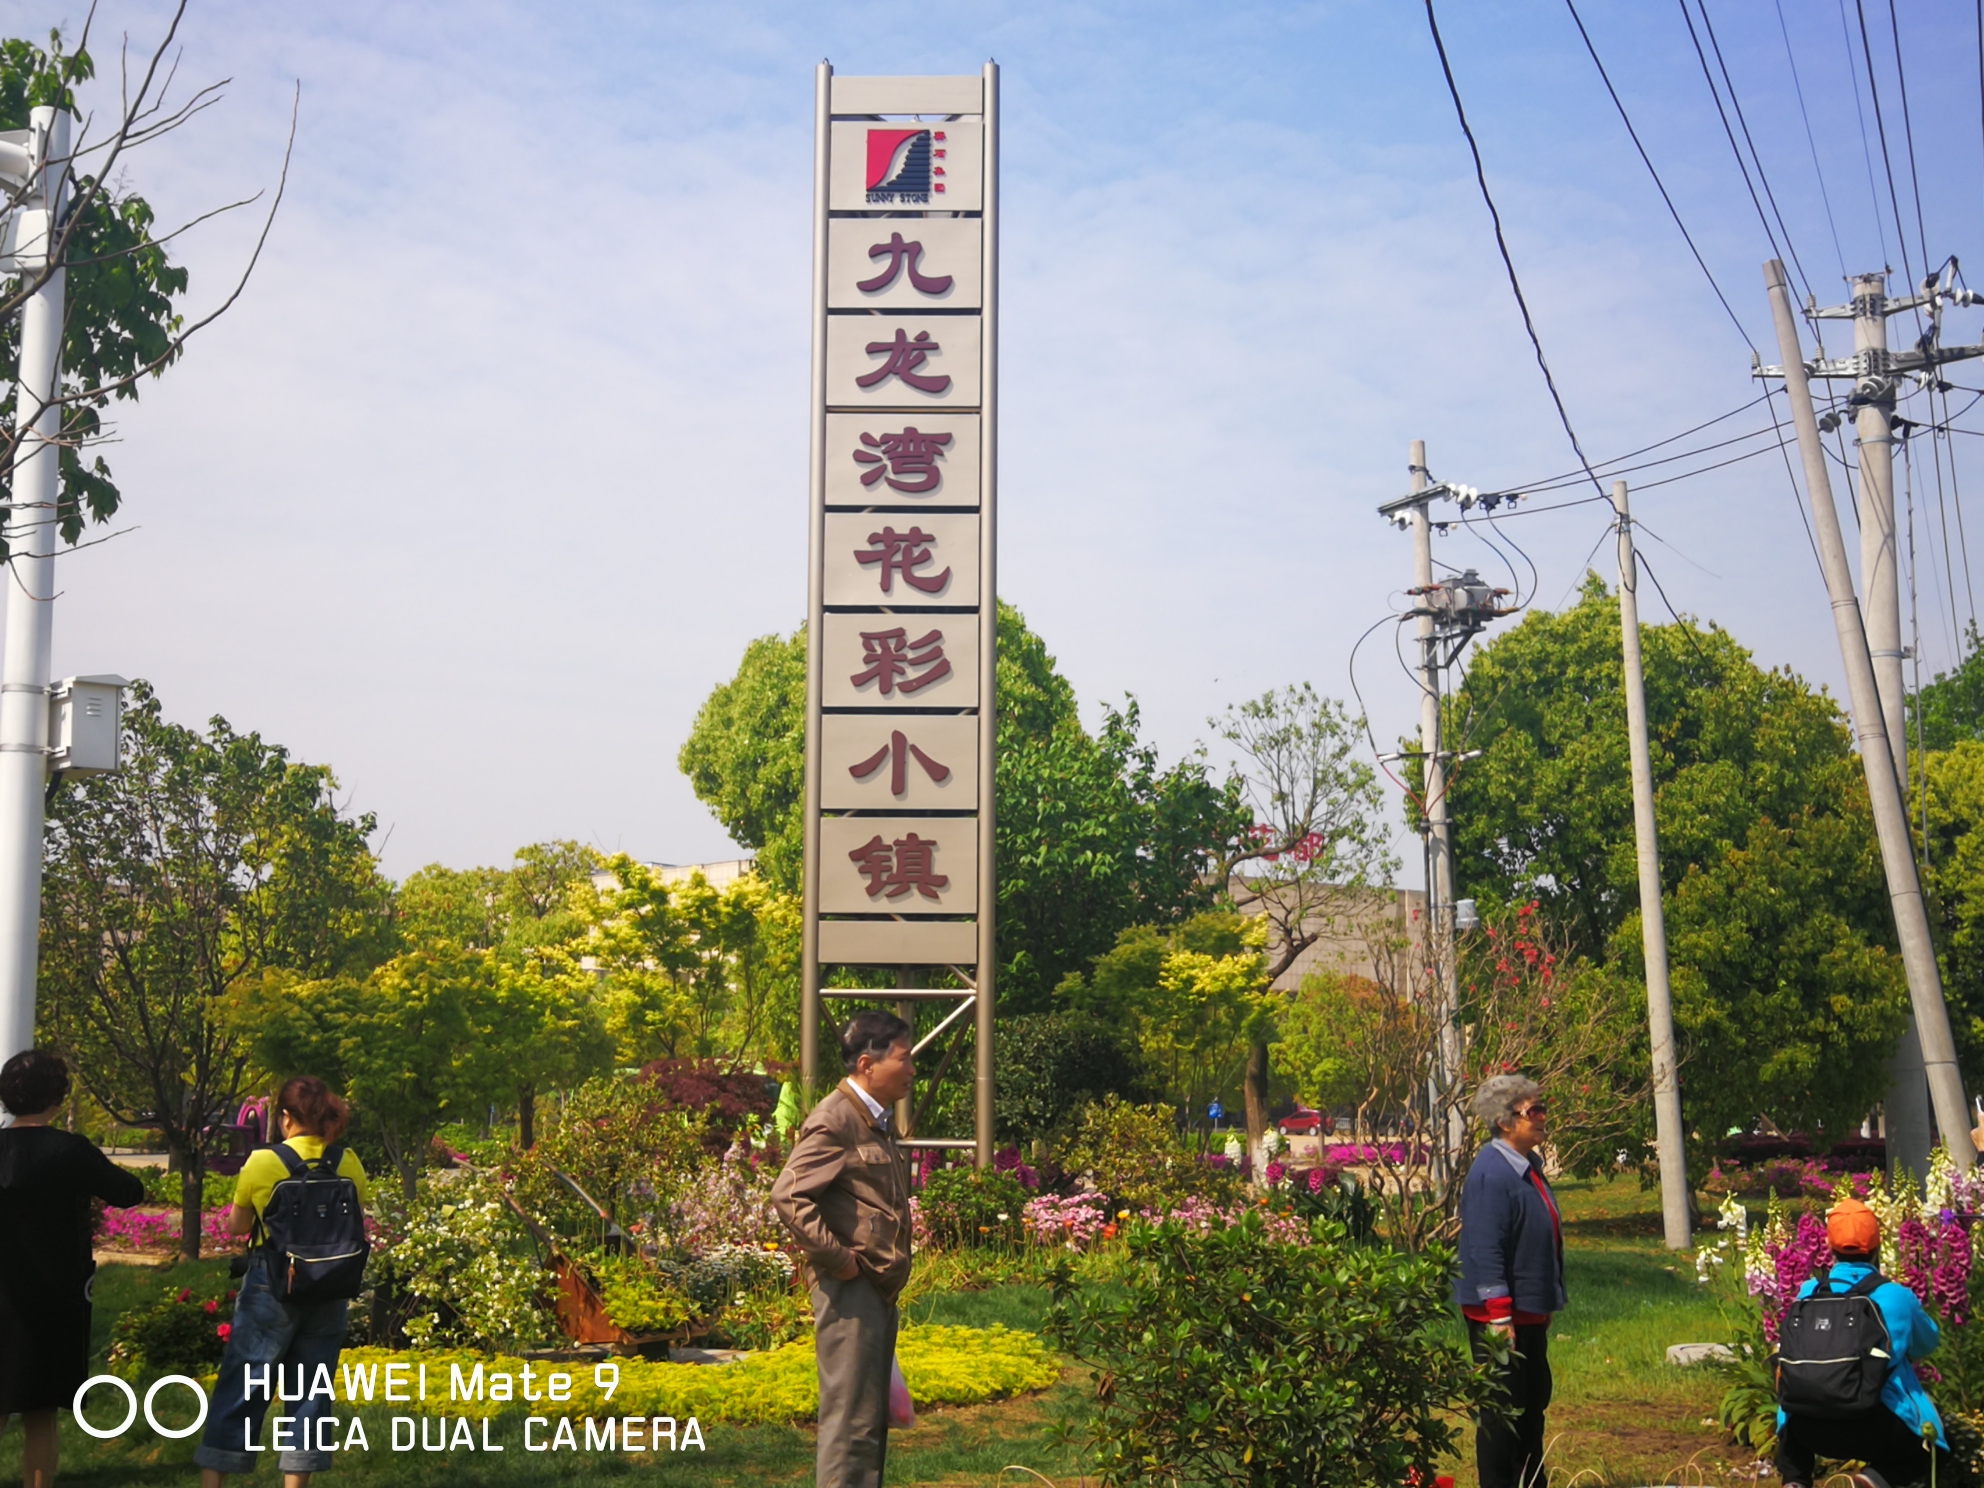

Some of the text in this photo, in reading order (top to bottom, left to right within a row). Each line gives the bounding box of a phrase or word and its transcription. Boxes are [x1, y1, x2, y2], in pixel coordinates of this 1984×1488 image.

[865, 193, 929, 203] SUNNY STONE
[848, 231, 953, 899] 九龙湾花彩小镇
